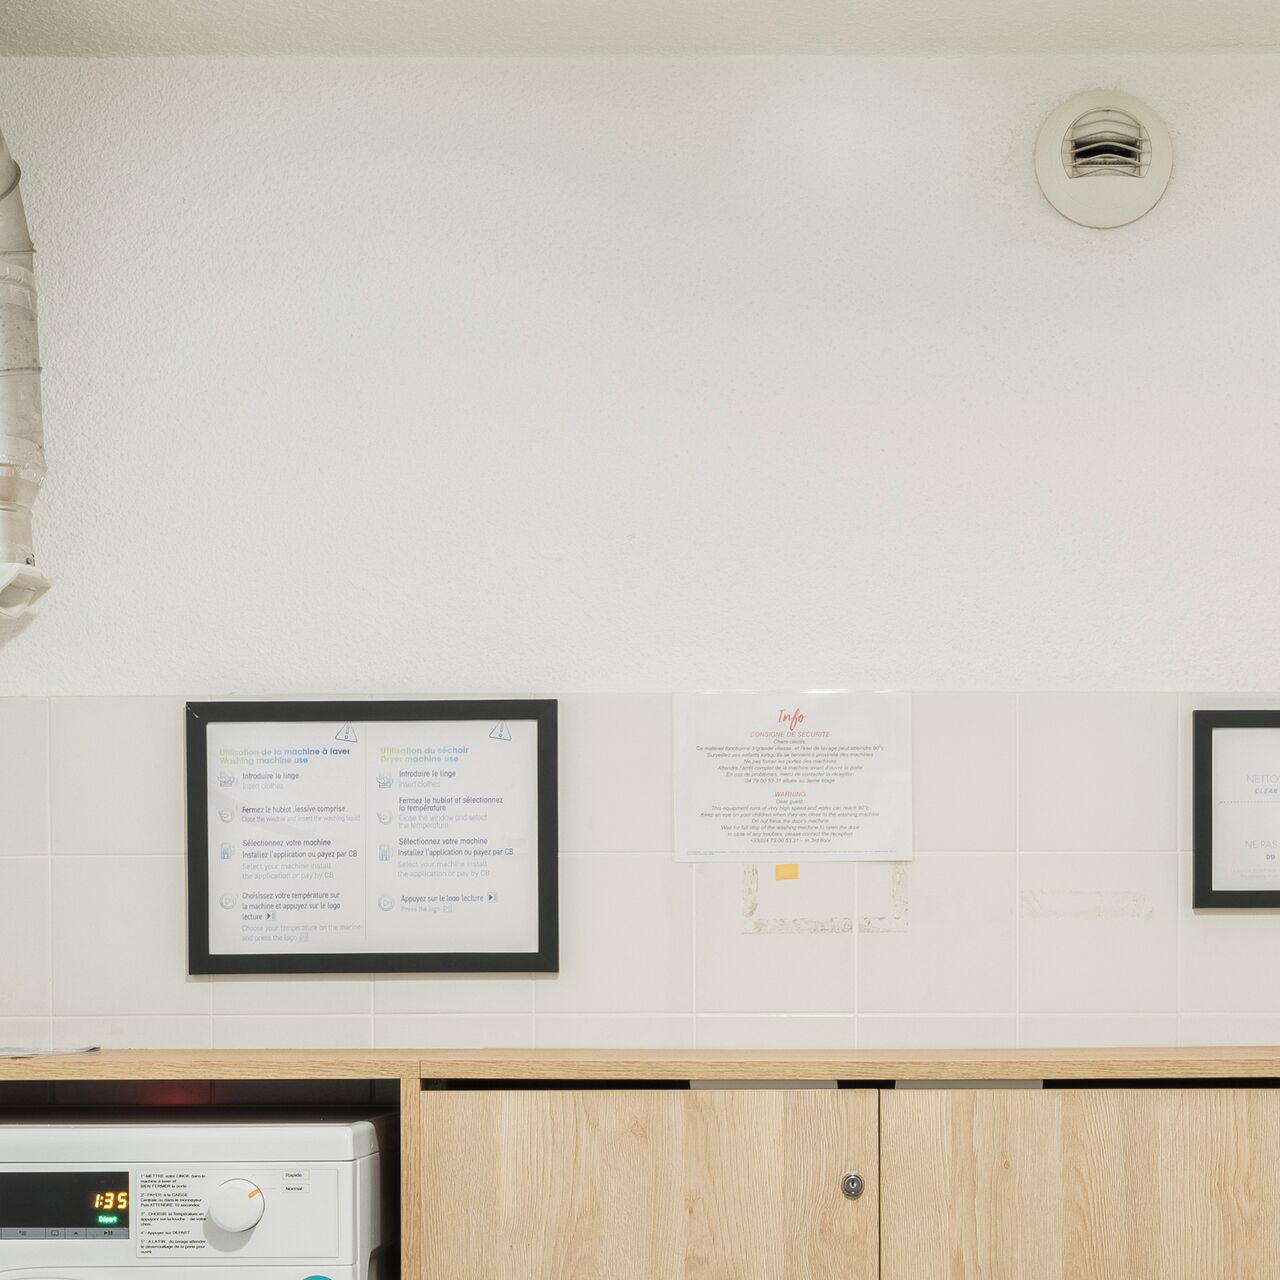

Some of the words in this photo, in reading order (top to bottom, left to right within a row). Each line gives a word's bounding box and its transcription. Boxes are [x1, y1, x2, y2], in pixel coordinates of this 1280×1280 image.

[776, 708, 806, 731] Info
[438, 746, 469, 754] séchoir
[243, 839, 284, 847] Sélectionnez
[1245, 840, 1258, 849] NE
[1261, 840, 1277, 848] PAS
[317, 851, 334, 859] payez
[94, 1192, 128, 1209] 1:35
[98, 1216, 117, 1224] Départ
